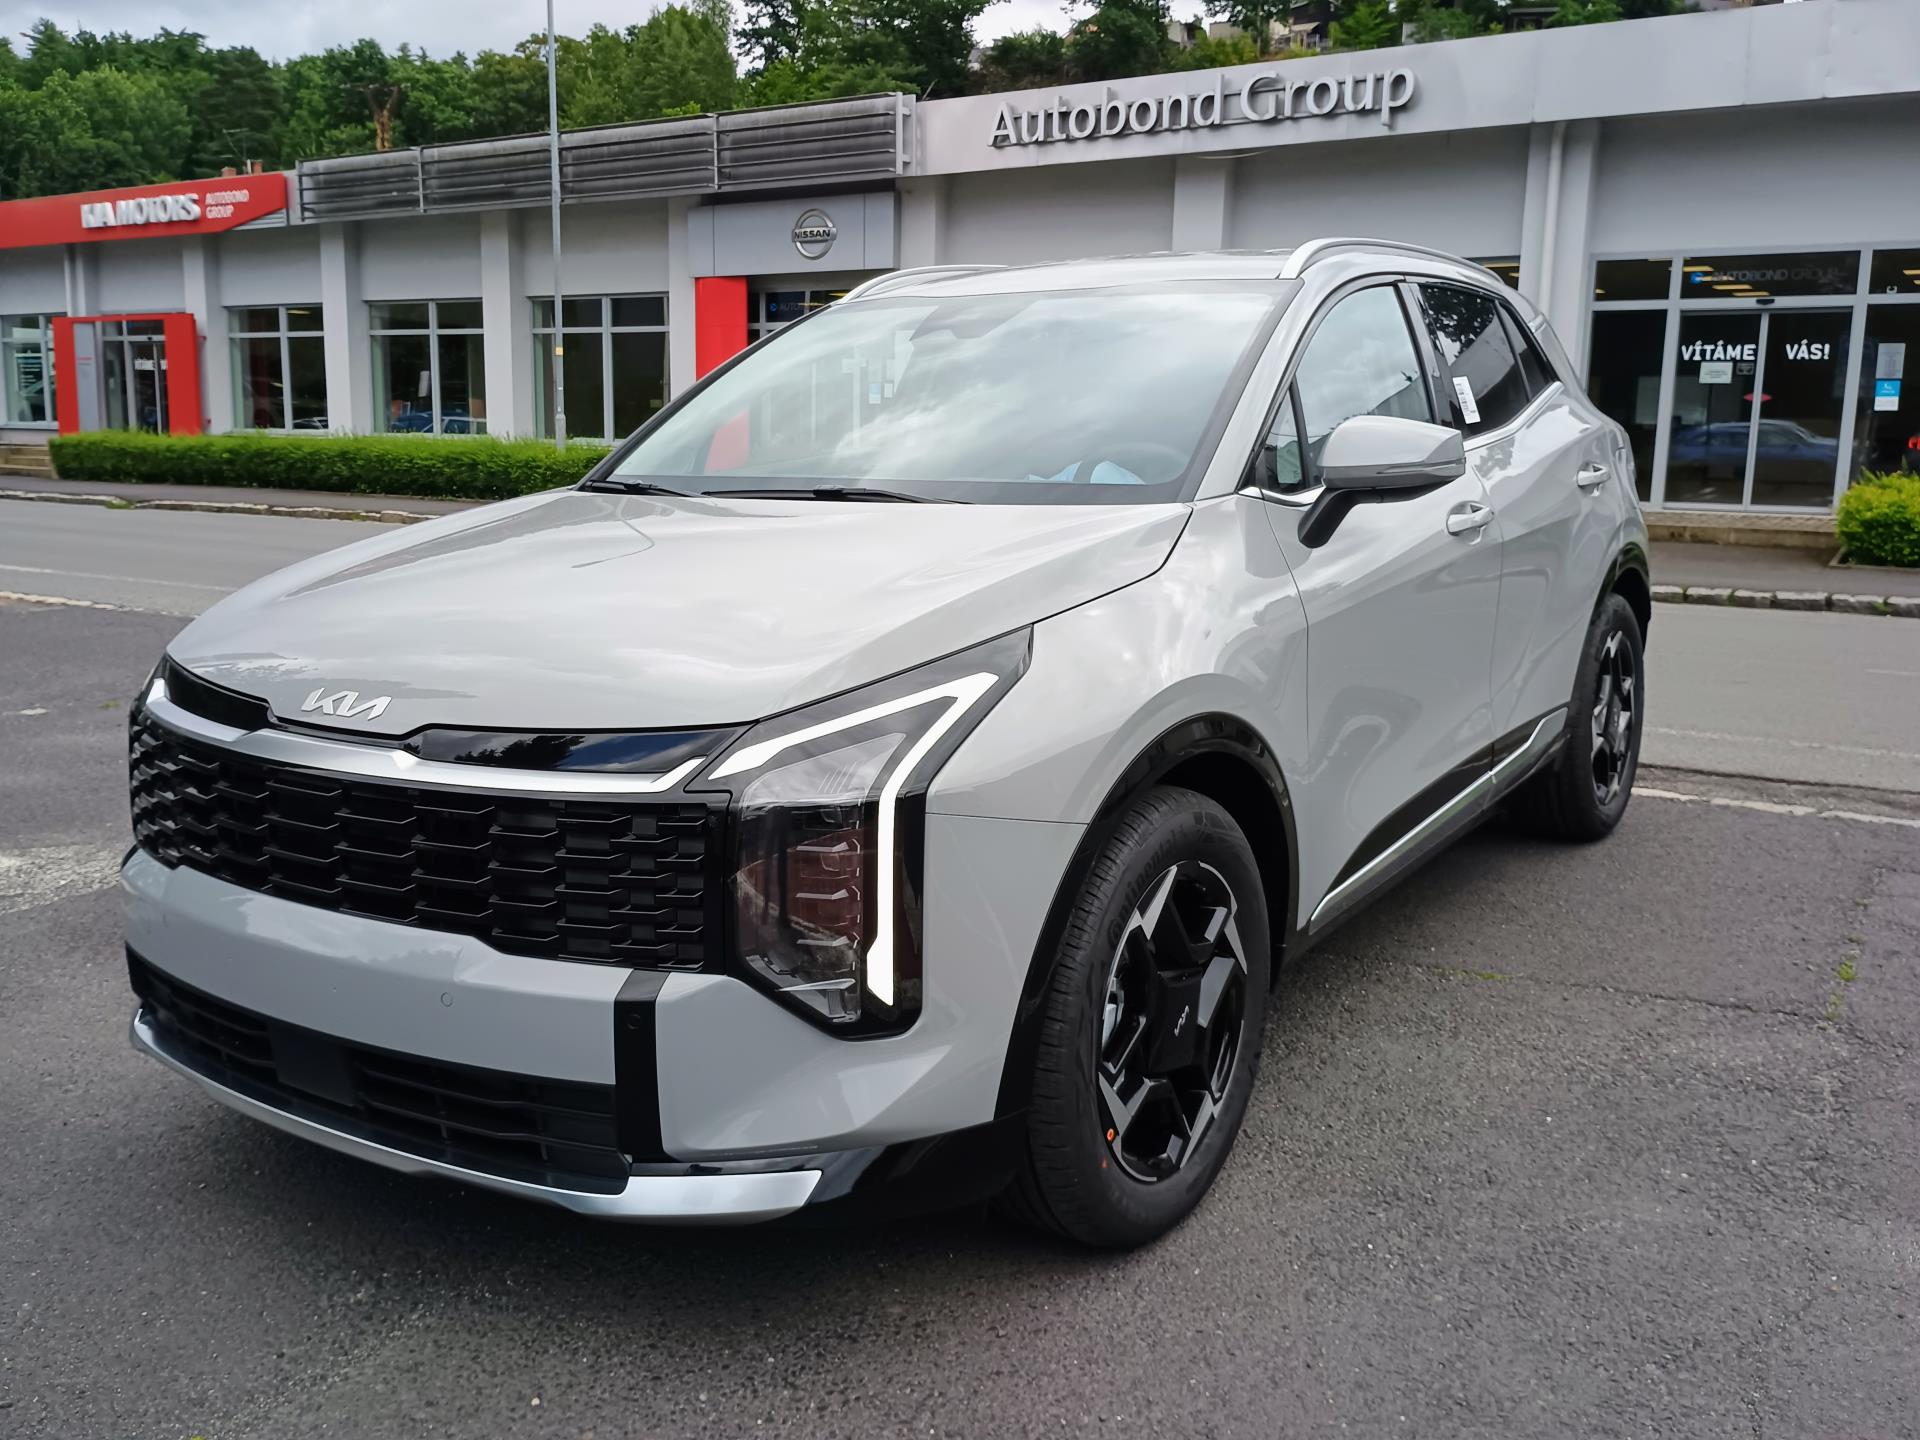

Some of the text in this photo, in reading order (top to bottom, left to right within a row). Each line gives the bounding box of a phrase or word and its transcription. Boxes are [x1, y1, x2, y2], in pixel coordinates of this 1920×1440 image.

[988, 68, 1416, 147] Autobond Group
[116, 193, 200, 225] MOTORS
[794, 229, 830, 239] NISSAN
[1682, 339, 1830, 361] VÍTÁME VÁS!
[301, 687, 392, 721] KIA
